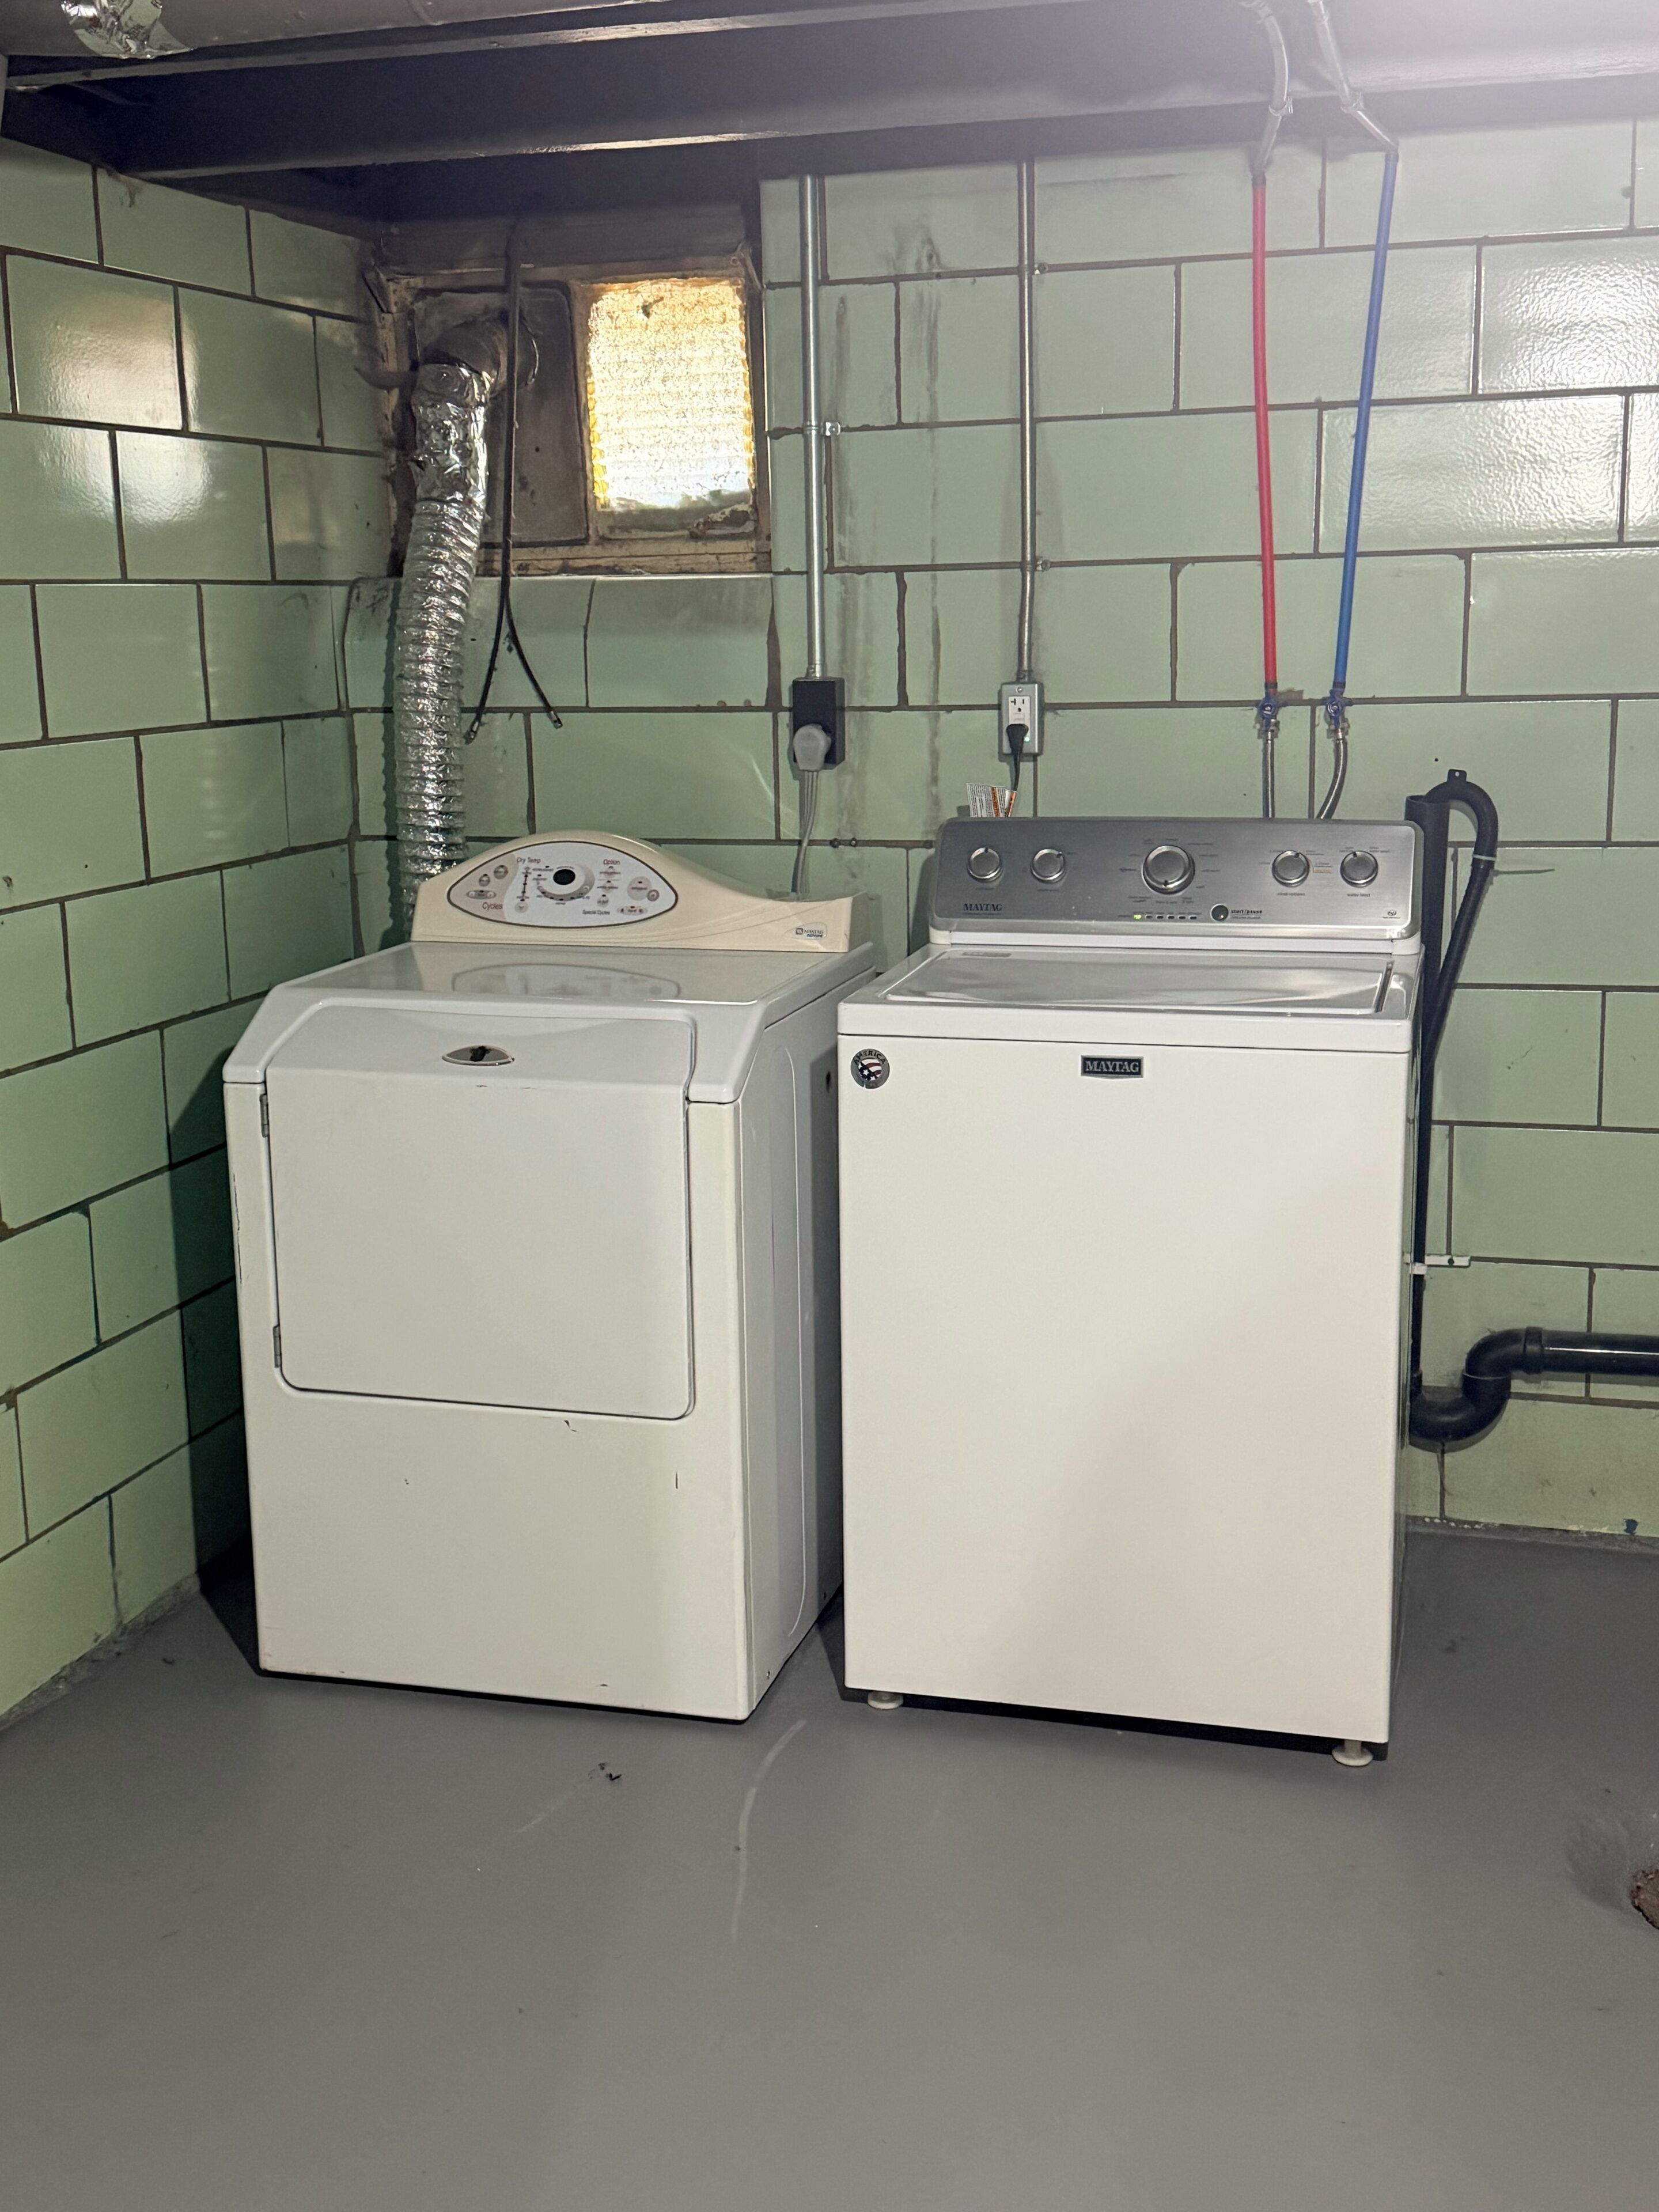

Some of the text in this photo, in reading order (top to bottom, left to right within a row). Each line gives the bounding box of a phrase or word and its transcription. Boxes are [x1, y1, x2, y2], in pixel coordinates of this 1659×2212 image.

[482, 902, 503, 911] Cycles
[963, 903, 1003, 911] MAYTAG
[854, 1050, 886, 1065] AMERICA
[1085, 1060, 1139, 1073] MAYTAG
